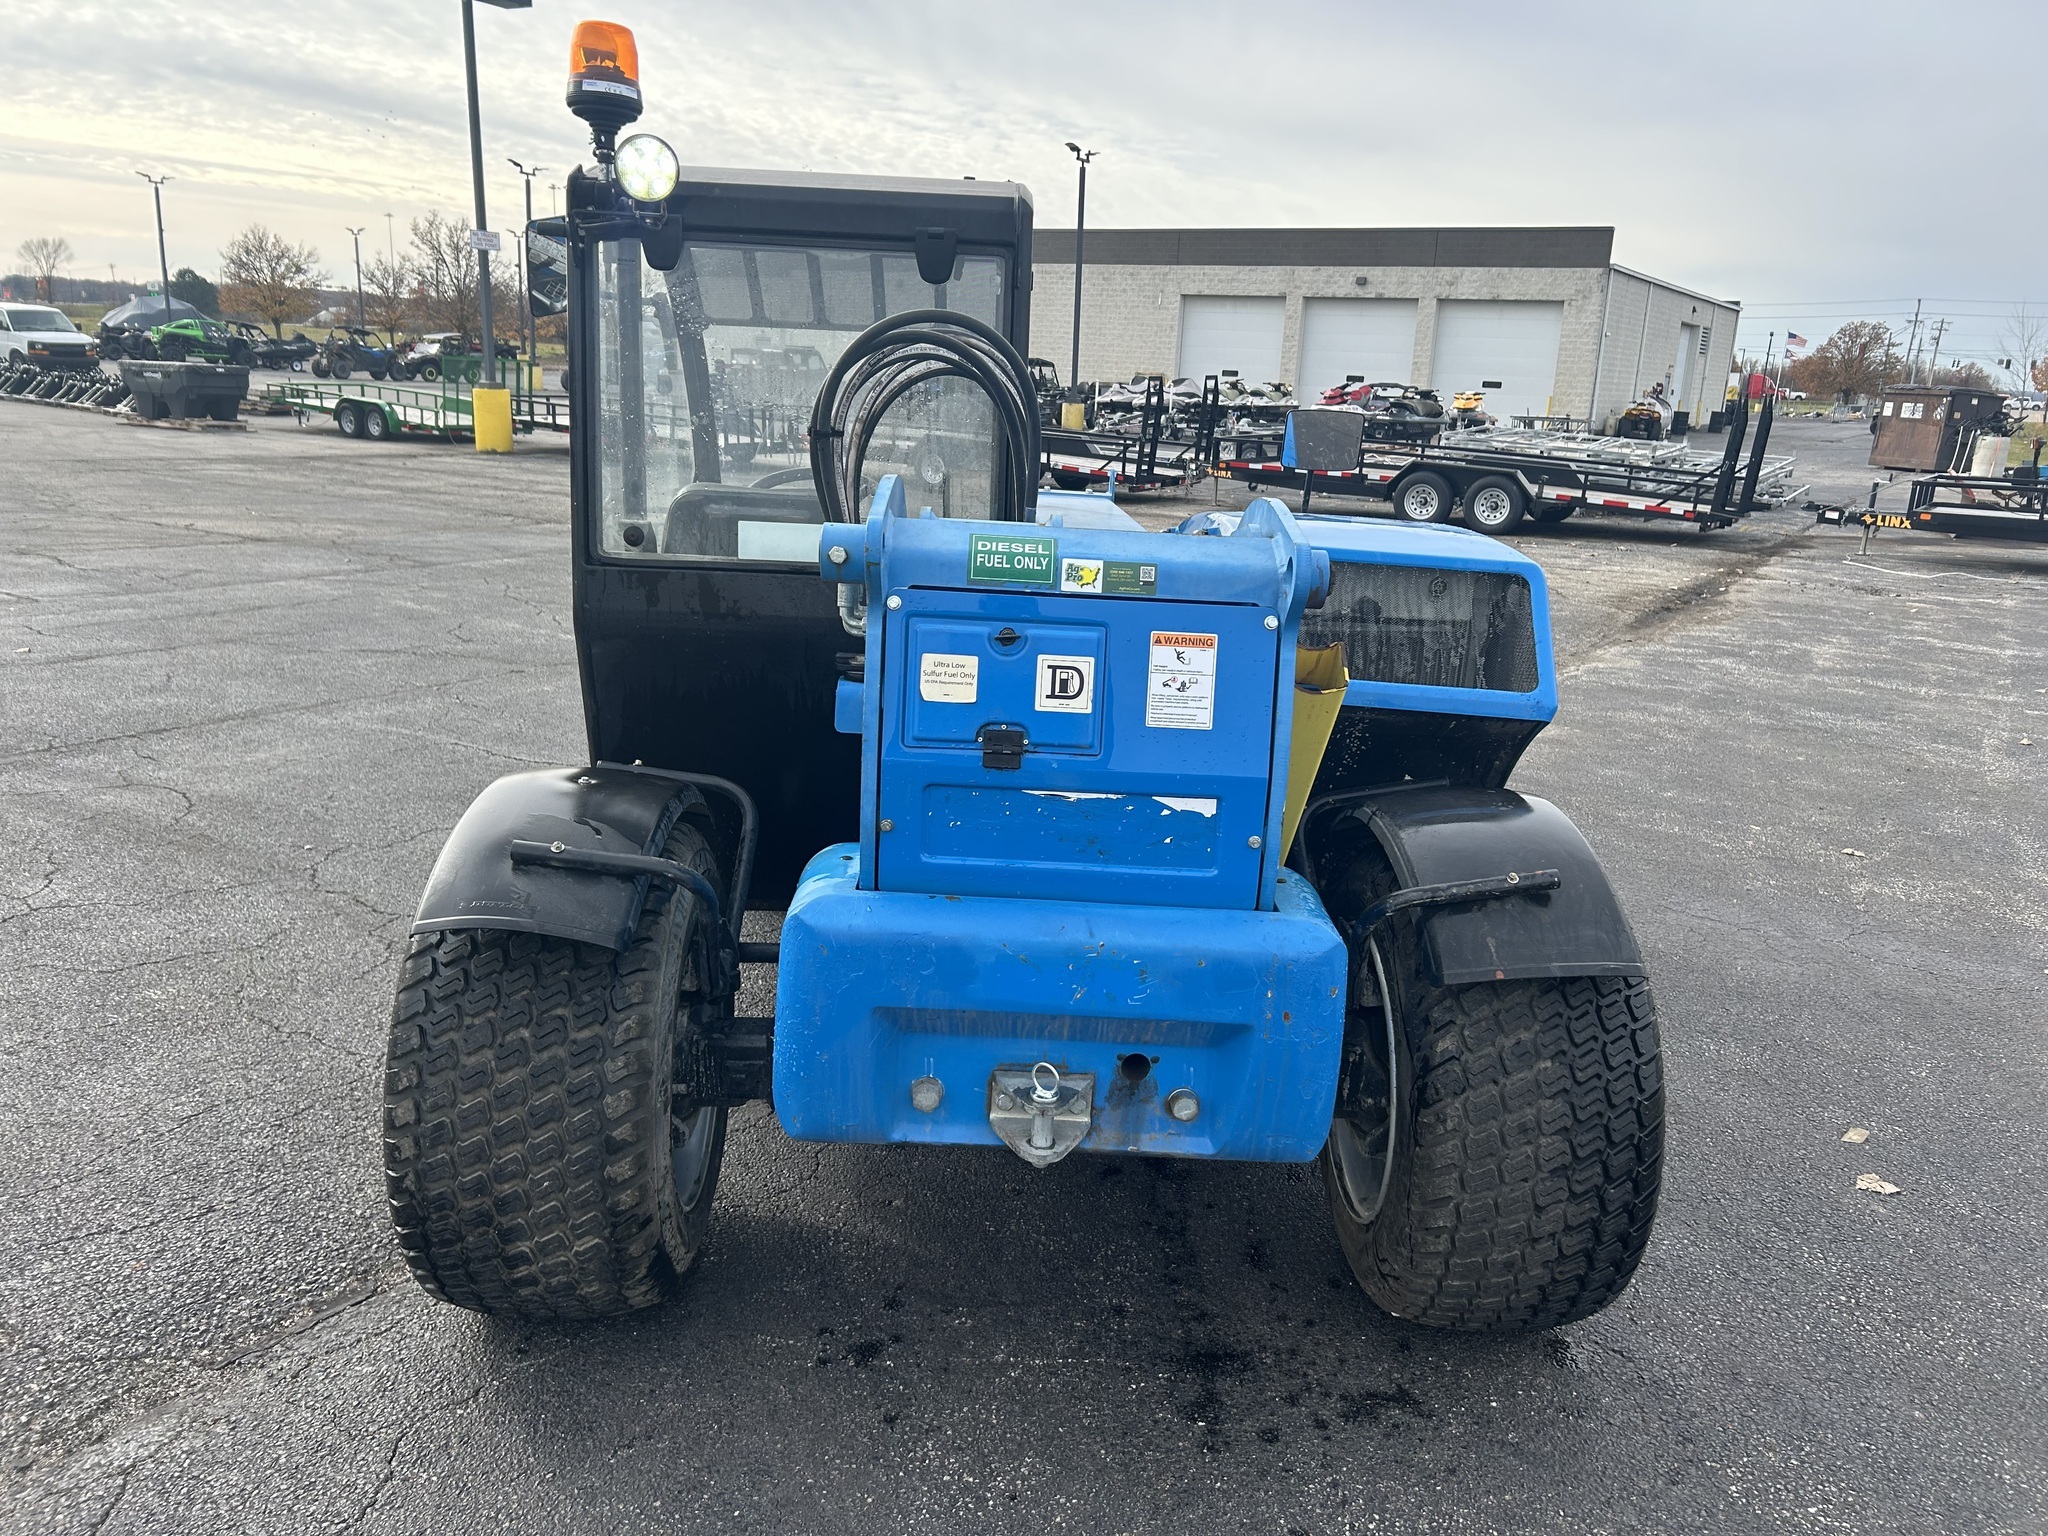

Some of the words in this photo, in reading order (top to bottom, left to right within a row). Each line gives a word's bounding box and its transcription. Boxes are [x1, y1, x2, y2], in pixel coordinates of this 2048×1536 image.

[1876, 514, 1912, 529] LINX
[977, 541, 1050, 554] DIESEL
[976, 553, 1011, 568] FUEL
[1014, 556, 1050, 570] ONLY
[1065, 572, 1083, 582] Pro
[1163, 636, 1214, 647] WARNING
[922, 669, 943, 677] Sulfur
[959, 672, 976, 681] Only
[1046, 664, 1084, 700] D
